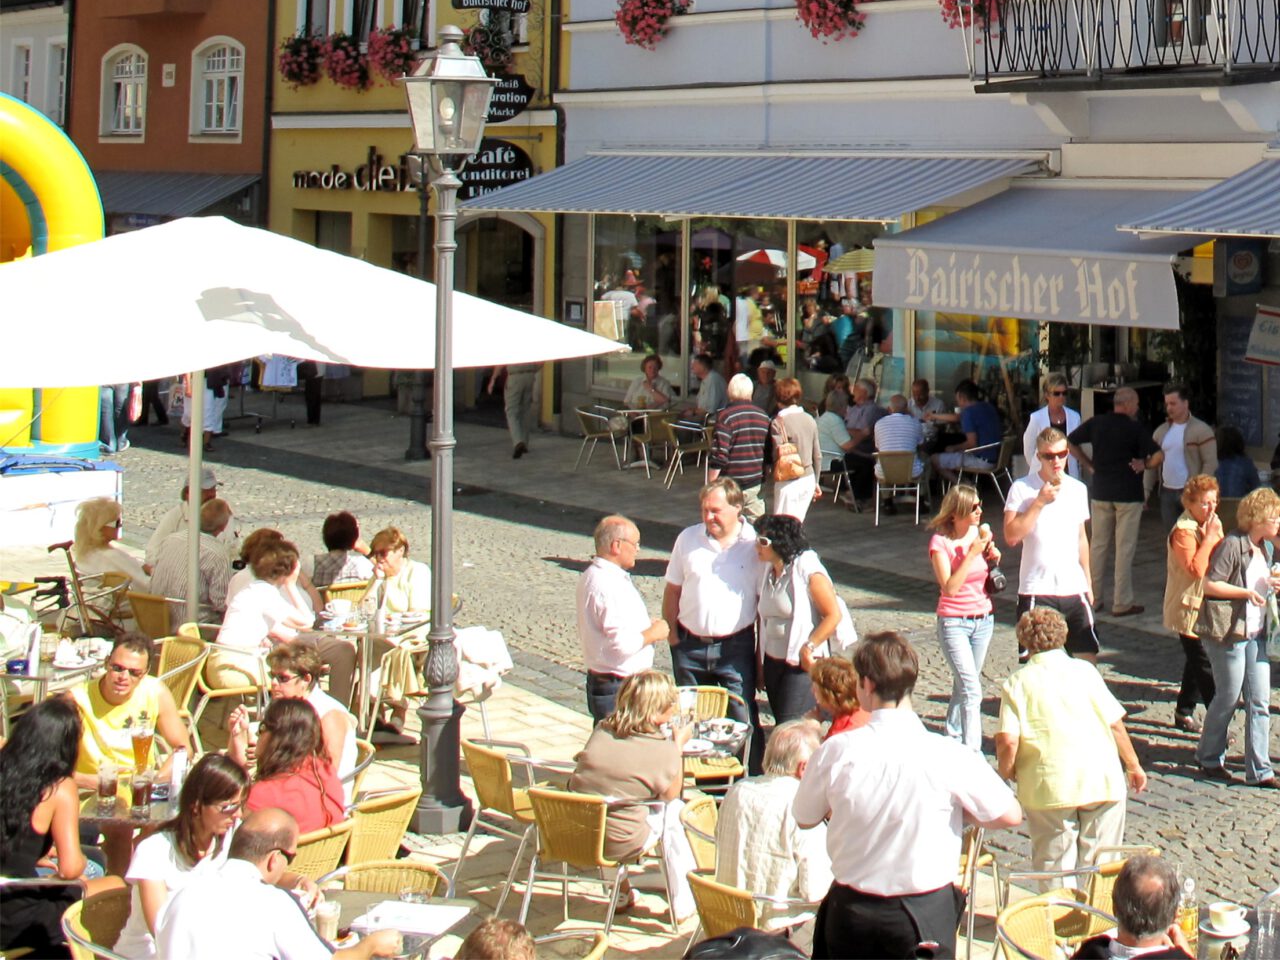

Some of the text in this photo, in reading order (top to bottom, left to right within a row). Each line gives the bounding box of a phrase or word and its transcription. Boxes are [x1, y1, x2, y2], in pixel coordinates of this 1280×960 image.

[495, 80, 519, 89] theiß
[490, 93, 527, 104] uration
[488, 107, 515, 117] Markt
[467, 146, 516, 165] Café
[293, 164, 352, 190] mode
[461, 167, 530, 181] onditorei
[904, 248, 1141, 321] Bairischer Hof
